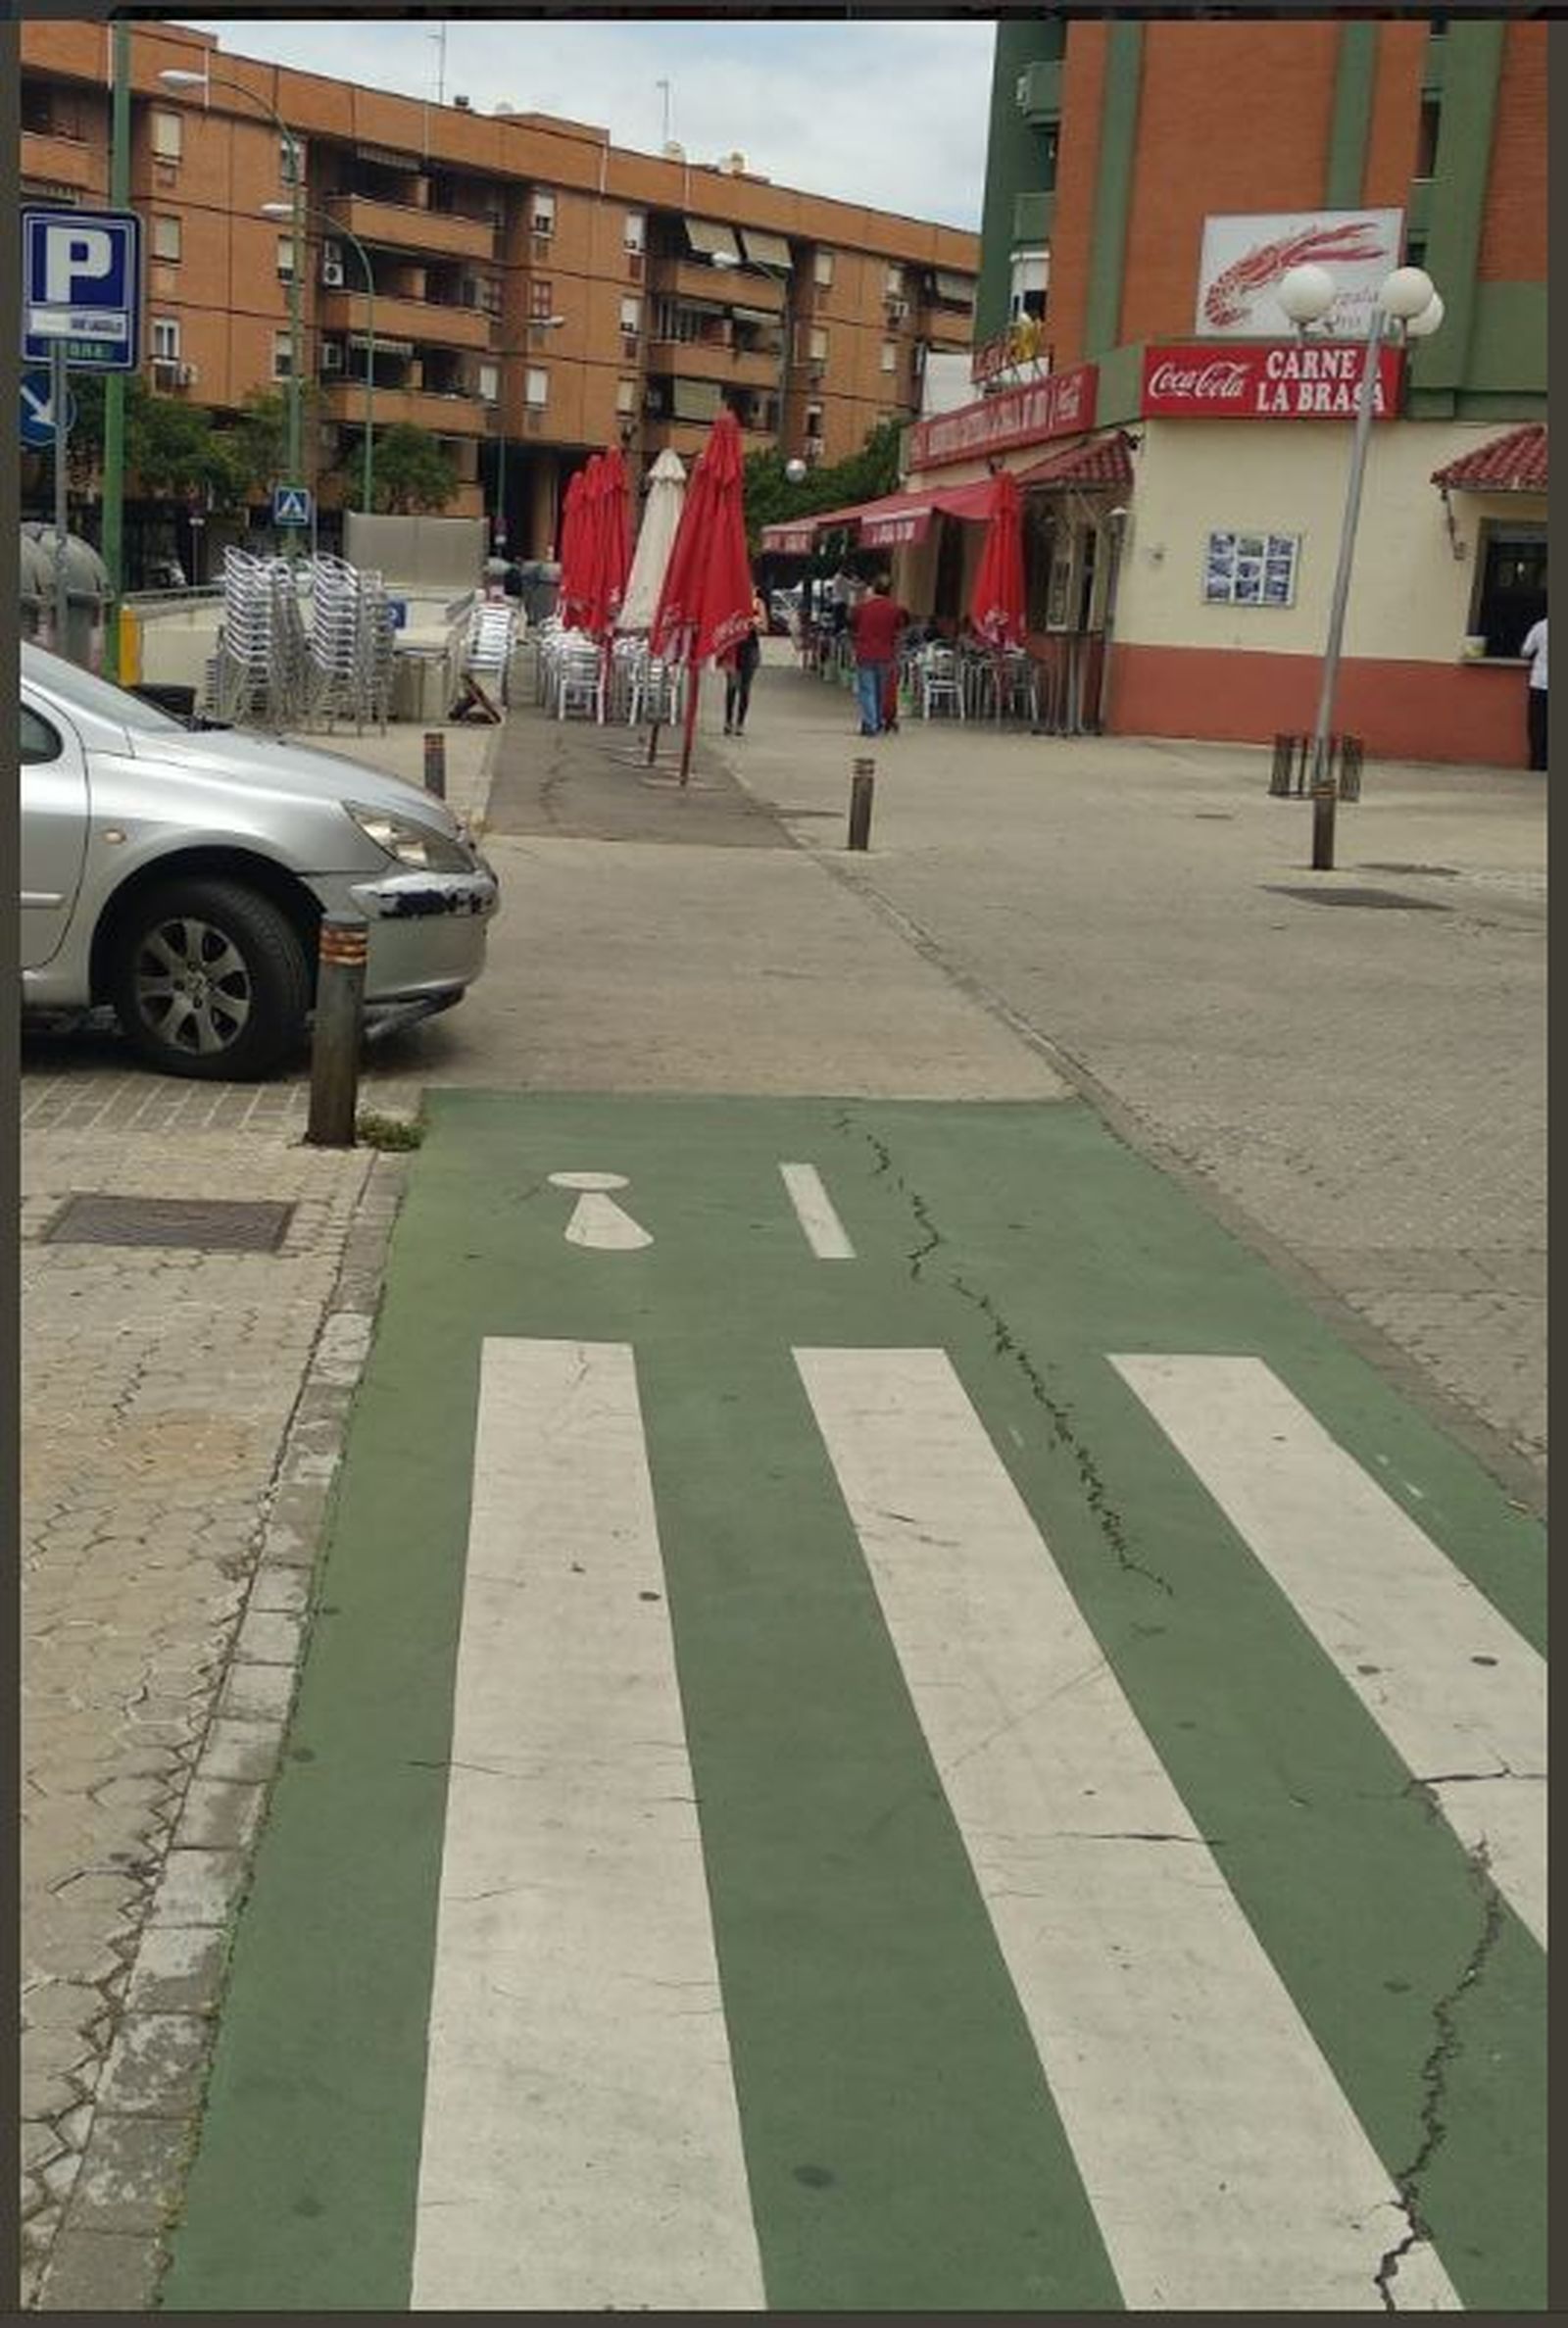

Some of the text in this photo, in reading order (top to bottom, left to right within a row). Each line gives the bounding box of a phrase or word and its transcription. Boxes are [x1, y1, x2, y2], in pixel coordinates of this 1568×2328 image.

[46, 226, 113, 303] P
[1148, 361, 1253, 399] Coca-Cola
[1266, 349, 1357, 379] CARNE
[1255, 381, 1290, 412] LA
